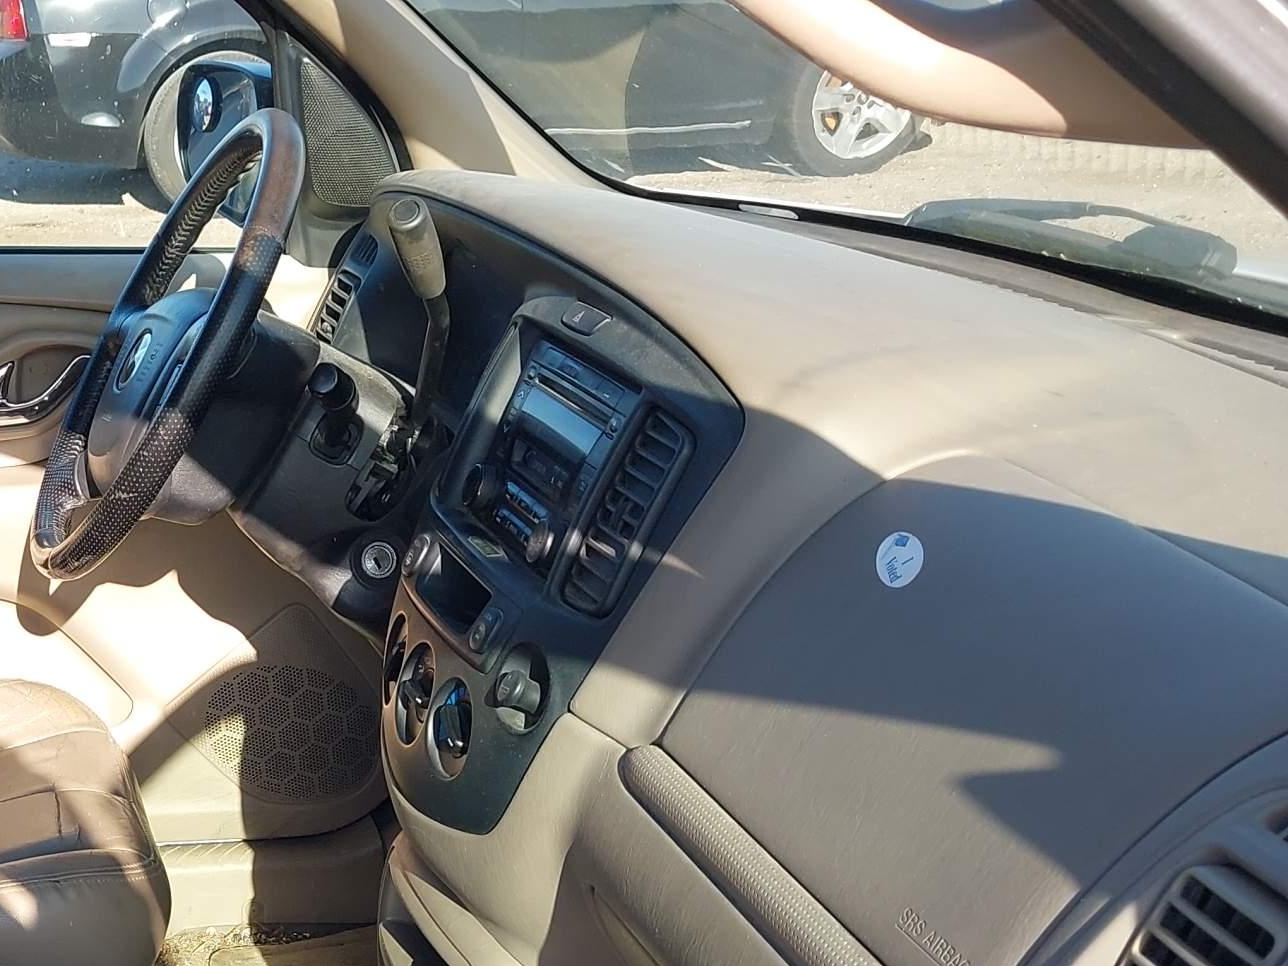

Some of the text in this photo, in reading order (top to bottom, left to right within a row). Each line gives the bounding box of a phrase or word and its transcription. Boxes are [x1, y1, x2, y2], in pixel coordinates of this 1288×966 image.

[885, 556, 903, 584] Voted
[902, 556, 913, 565] I
[899, 907, 927, 937] SRS
